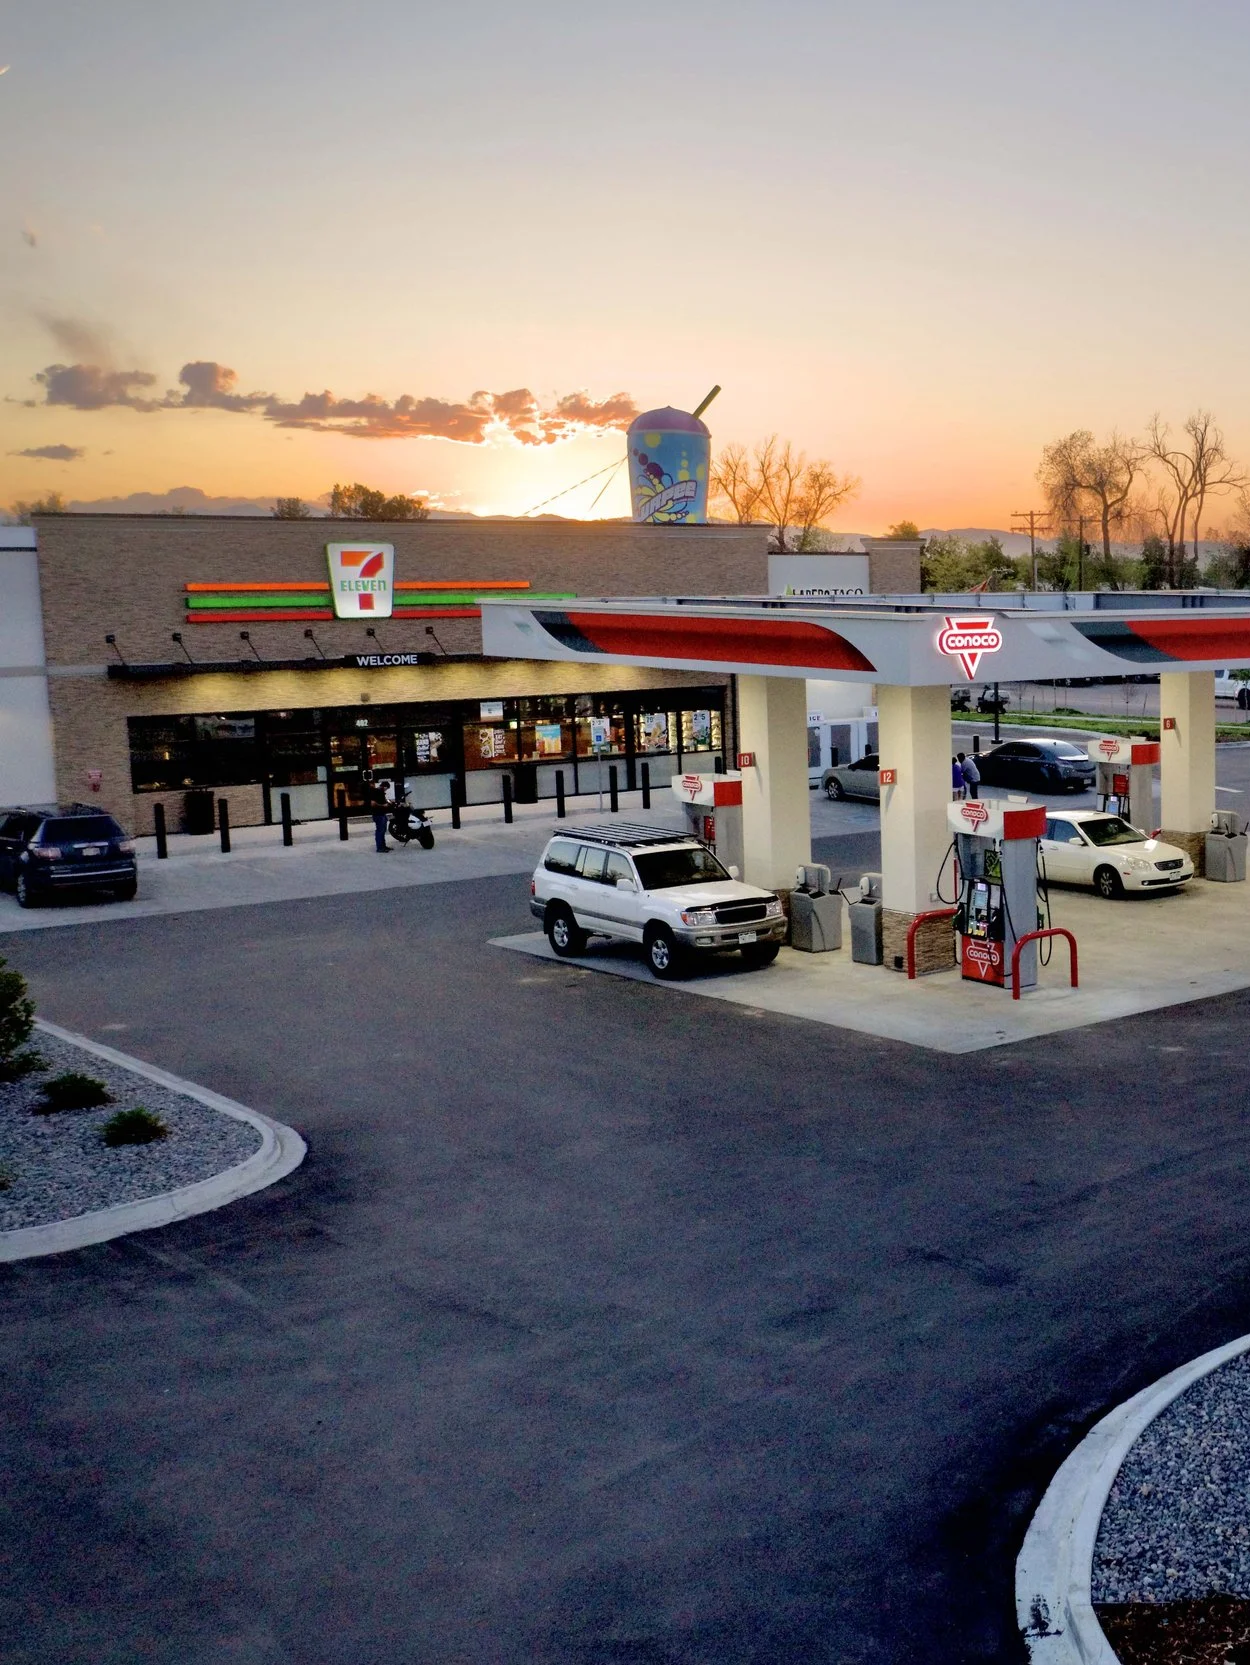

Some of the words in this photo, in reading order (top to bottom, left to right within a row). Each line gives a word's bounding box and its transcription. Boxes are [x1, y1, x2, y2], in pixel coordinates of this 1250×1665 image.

[341, 551, 384, 610] 7
[356, 654, 418, 666] WELCOME
[883, 772, 892, 783] 12
